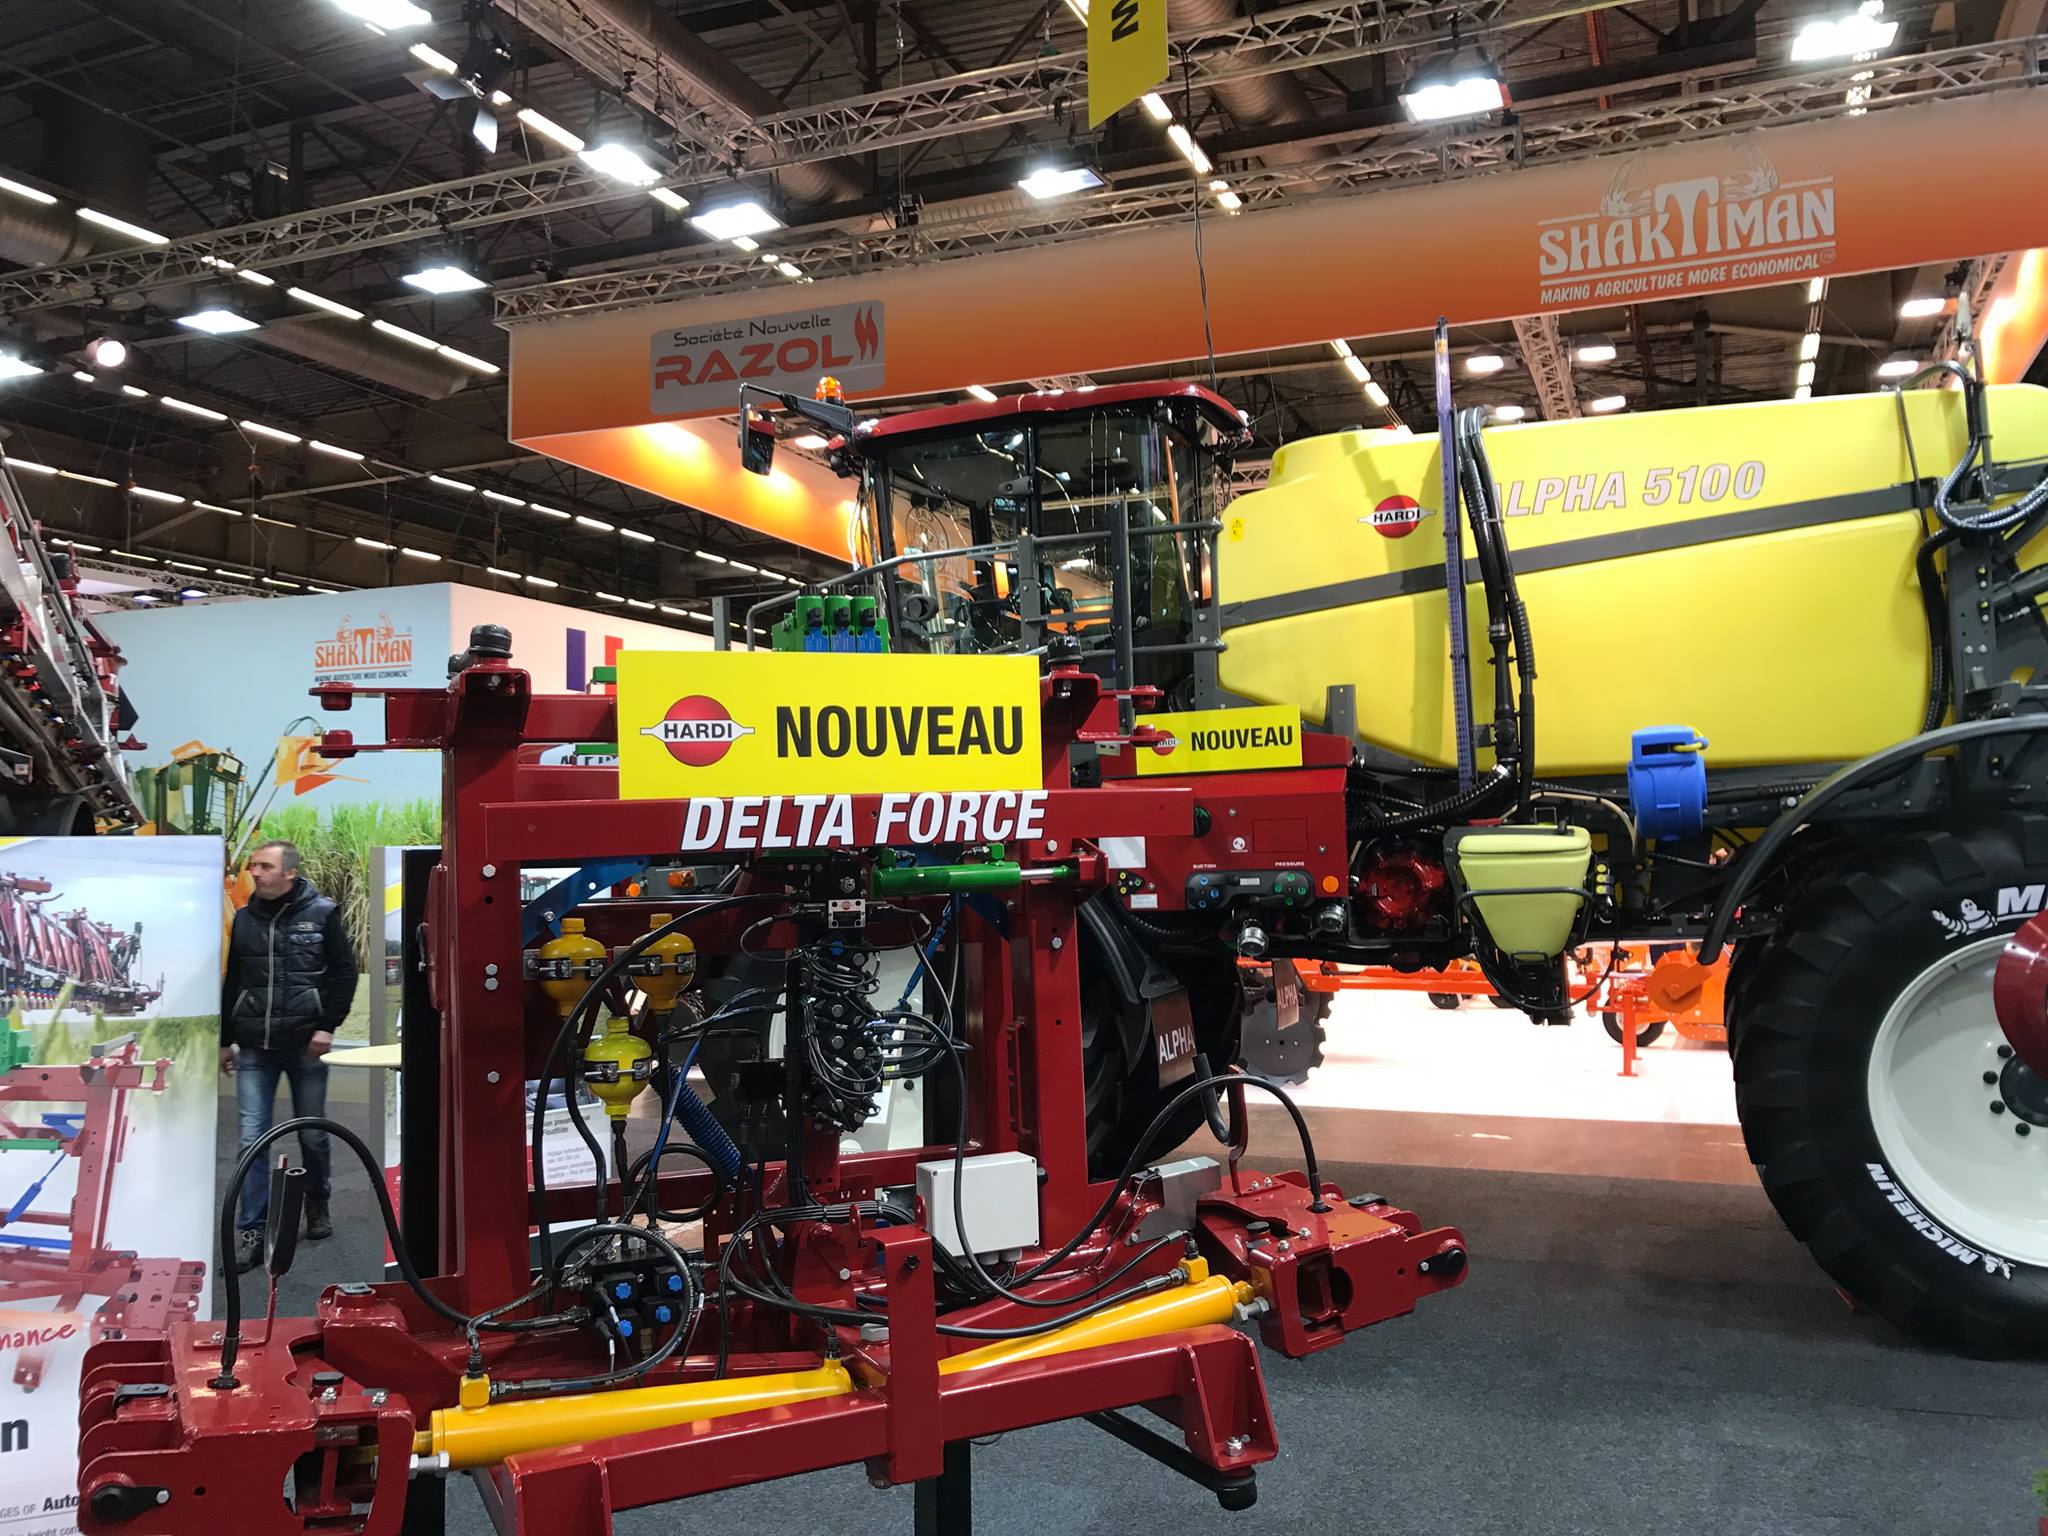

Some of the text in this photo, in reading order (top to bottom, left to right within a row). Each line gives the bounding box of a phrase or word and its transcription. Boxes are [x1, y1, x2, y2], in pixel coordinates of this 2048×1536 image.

[1538, 176, 1836, 276] SHAKTIMAN
[1540, 284, 1590, 304] MAKING
[1594, 273, 1683, 297] AGRICULTURE
[1688, 266, 1727, 285] MORE
[1731, 253, 1820, 281] ECONOMICAL
[673, 315, 832, 348] Société Nouvelle
[655, 334, 853, 390] RAZOL
[1642, 460, 1766, 507] 5100
[1373, 508, 1420, 523] HARDI
[315, 627, 412, 668] SHAKTIMAN
[663, 705, 1023, 758] HARDI NOUVEAU
[1191, 725, 1293, 751] NOUVEAU
[680, 788, 1050, 852] DELTA FORCE
[1997, 884, 2048, 916] M
[1278, 984, 1299, 1010] ALPHA
[1159, 1024, 1196, 1065] ALPHA
[1866, 1162, 1980, 1266] MICHELIN
[22, 1503, 37, 1516] OF
